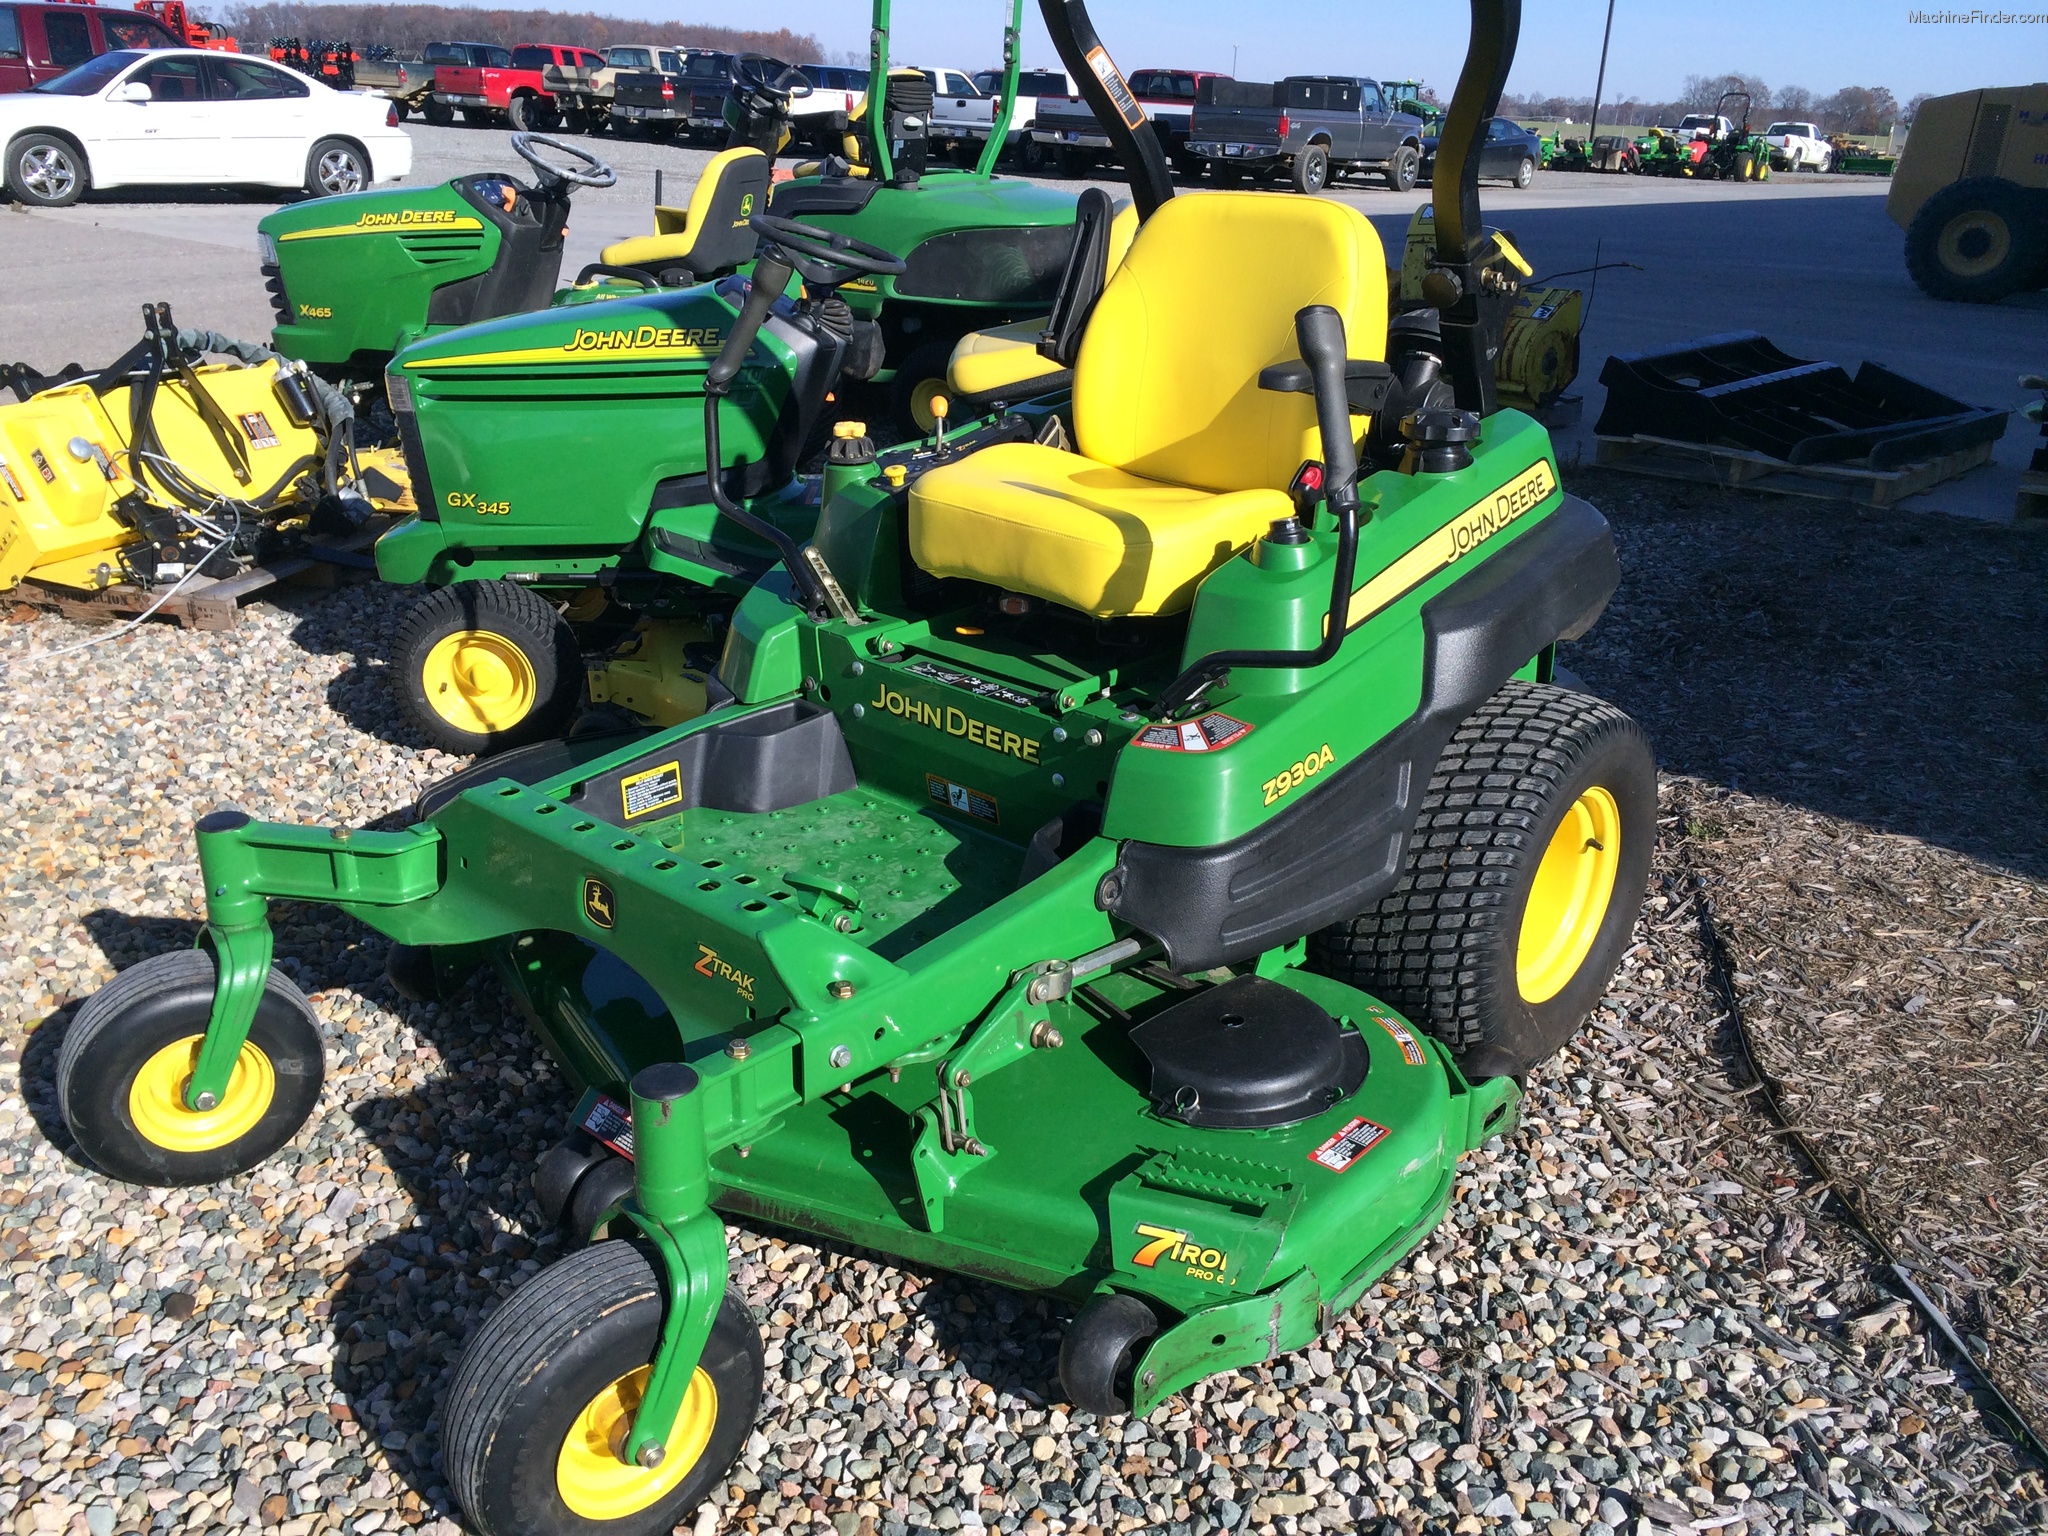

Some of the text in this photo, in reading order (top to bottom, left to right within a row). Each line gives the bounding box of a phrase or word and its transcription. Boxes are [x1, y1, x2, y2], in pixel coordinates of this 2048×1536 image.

[356, 210, 456, 227] JOHN DEERE
[299, 304, 333, 318] X465
[564, 326, 720, 351] JOHN DEERE
[1448, 473, 1546, 560] JOHN DEERE
[872, 683, 942, 730] JOHN
[946, 706, 1040, 765] DEERE
[1262, 743, 1335, 808] Z930A
[736, 987, 755, 1002] PRO
[1186, 1267, 1214, 1281] PRO
